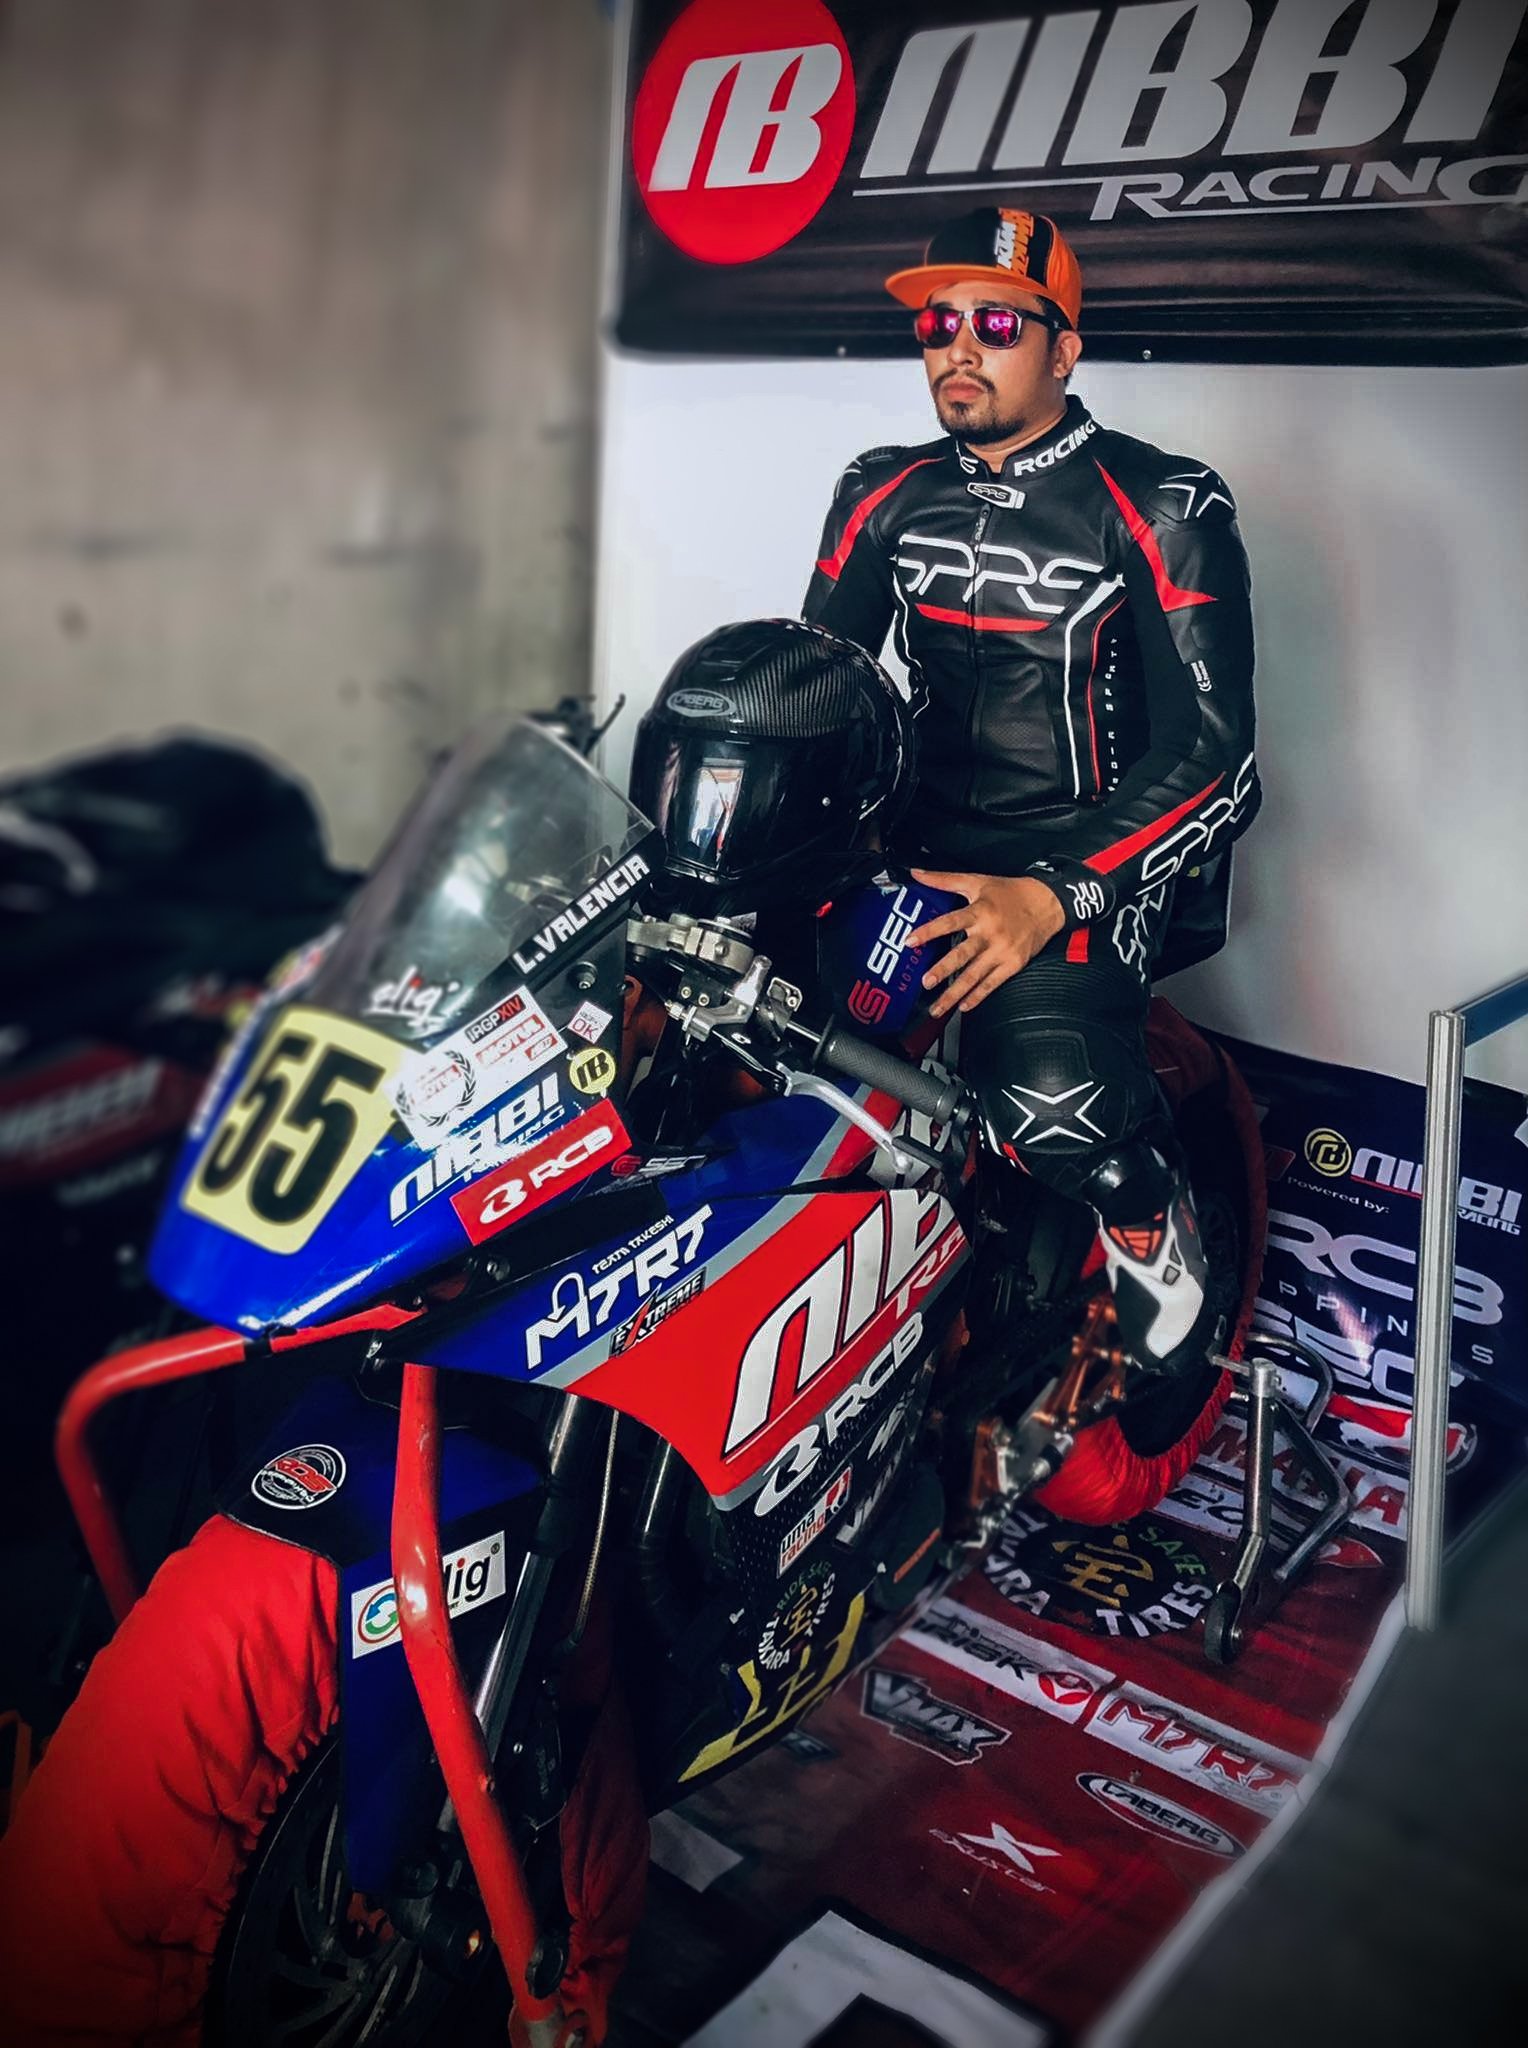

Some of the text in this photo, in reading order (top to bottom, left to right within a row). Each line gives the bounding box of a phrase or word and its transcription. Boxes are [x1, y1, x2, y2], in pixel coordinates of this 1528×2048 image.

[860, 0, 1526, 178] NIBBI
[1088, 152, 1528, 221] RACING
[1013, 419, 1097, 477] RACING
[513, 854, 650, 974] L.VALENCIA
[867, 886, 924, 984] SEC
[572, 1018, 598, 1040] OK
[202, 1033, 385, 1226] 55
[529, 1125, 613, 1189] RCB
[1352, 1148, 1522, 1222] NIBI
[628, 1214, 674, 1249] TAKESHI
[825, 1311, 924, 1444] RCB
[781, 1509, 816, 1551] uma
[781, 1513, 825, 1568] racing
[1096, 1581, 1213, 1638] TIRES
[1101, 1781, 1222, 1848] CABERG
